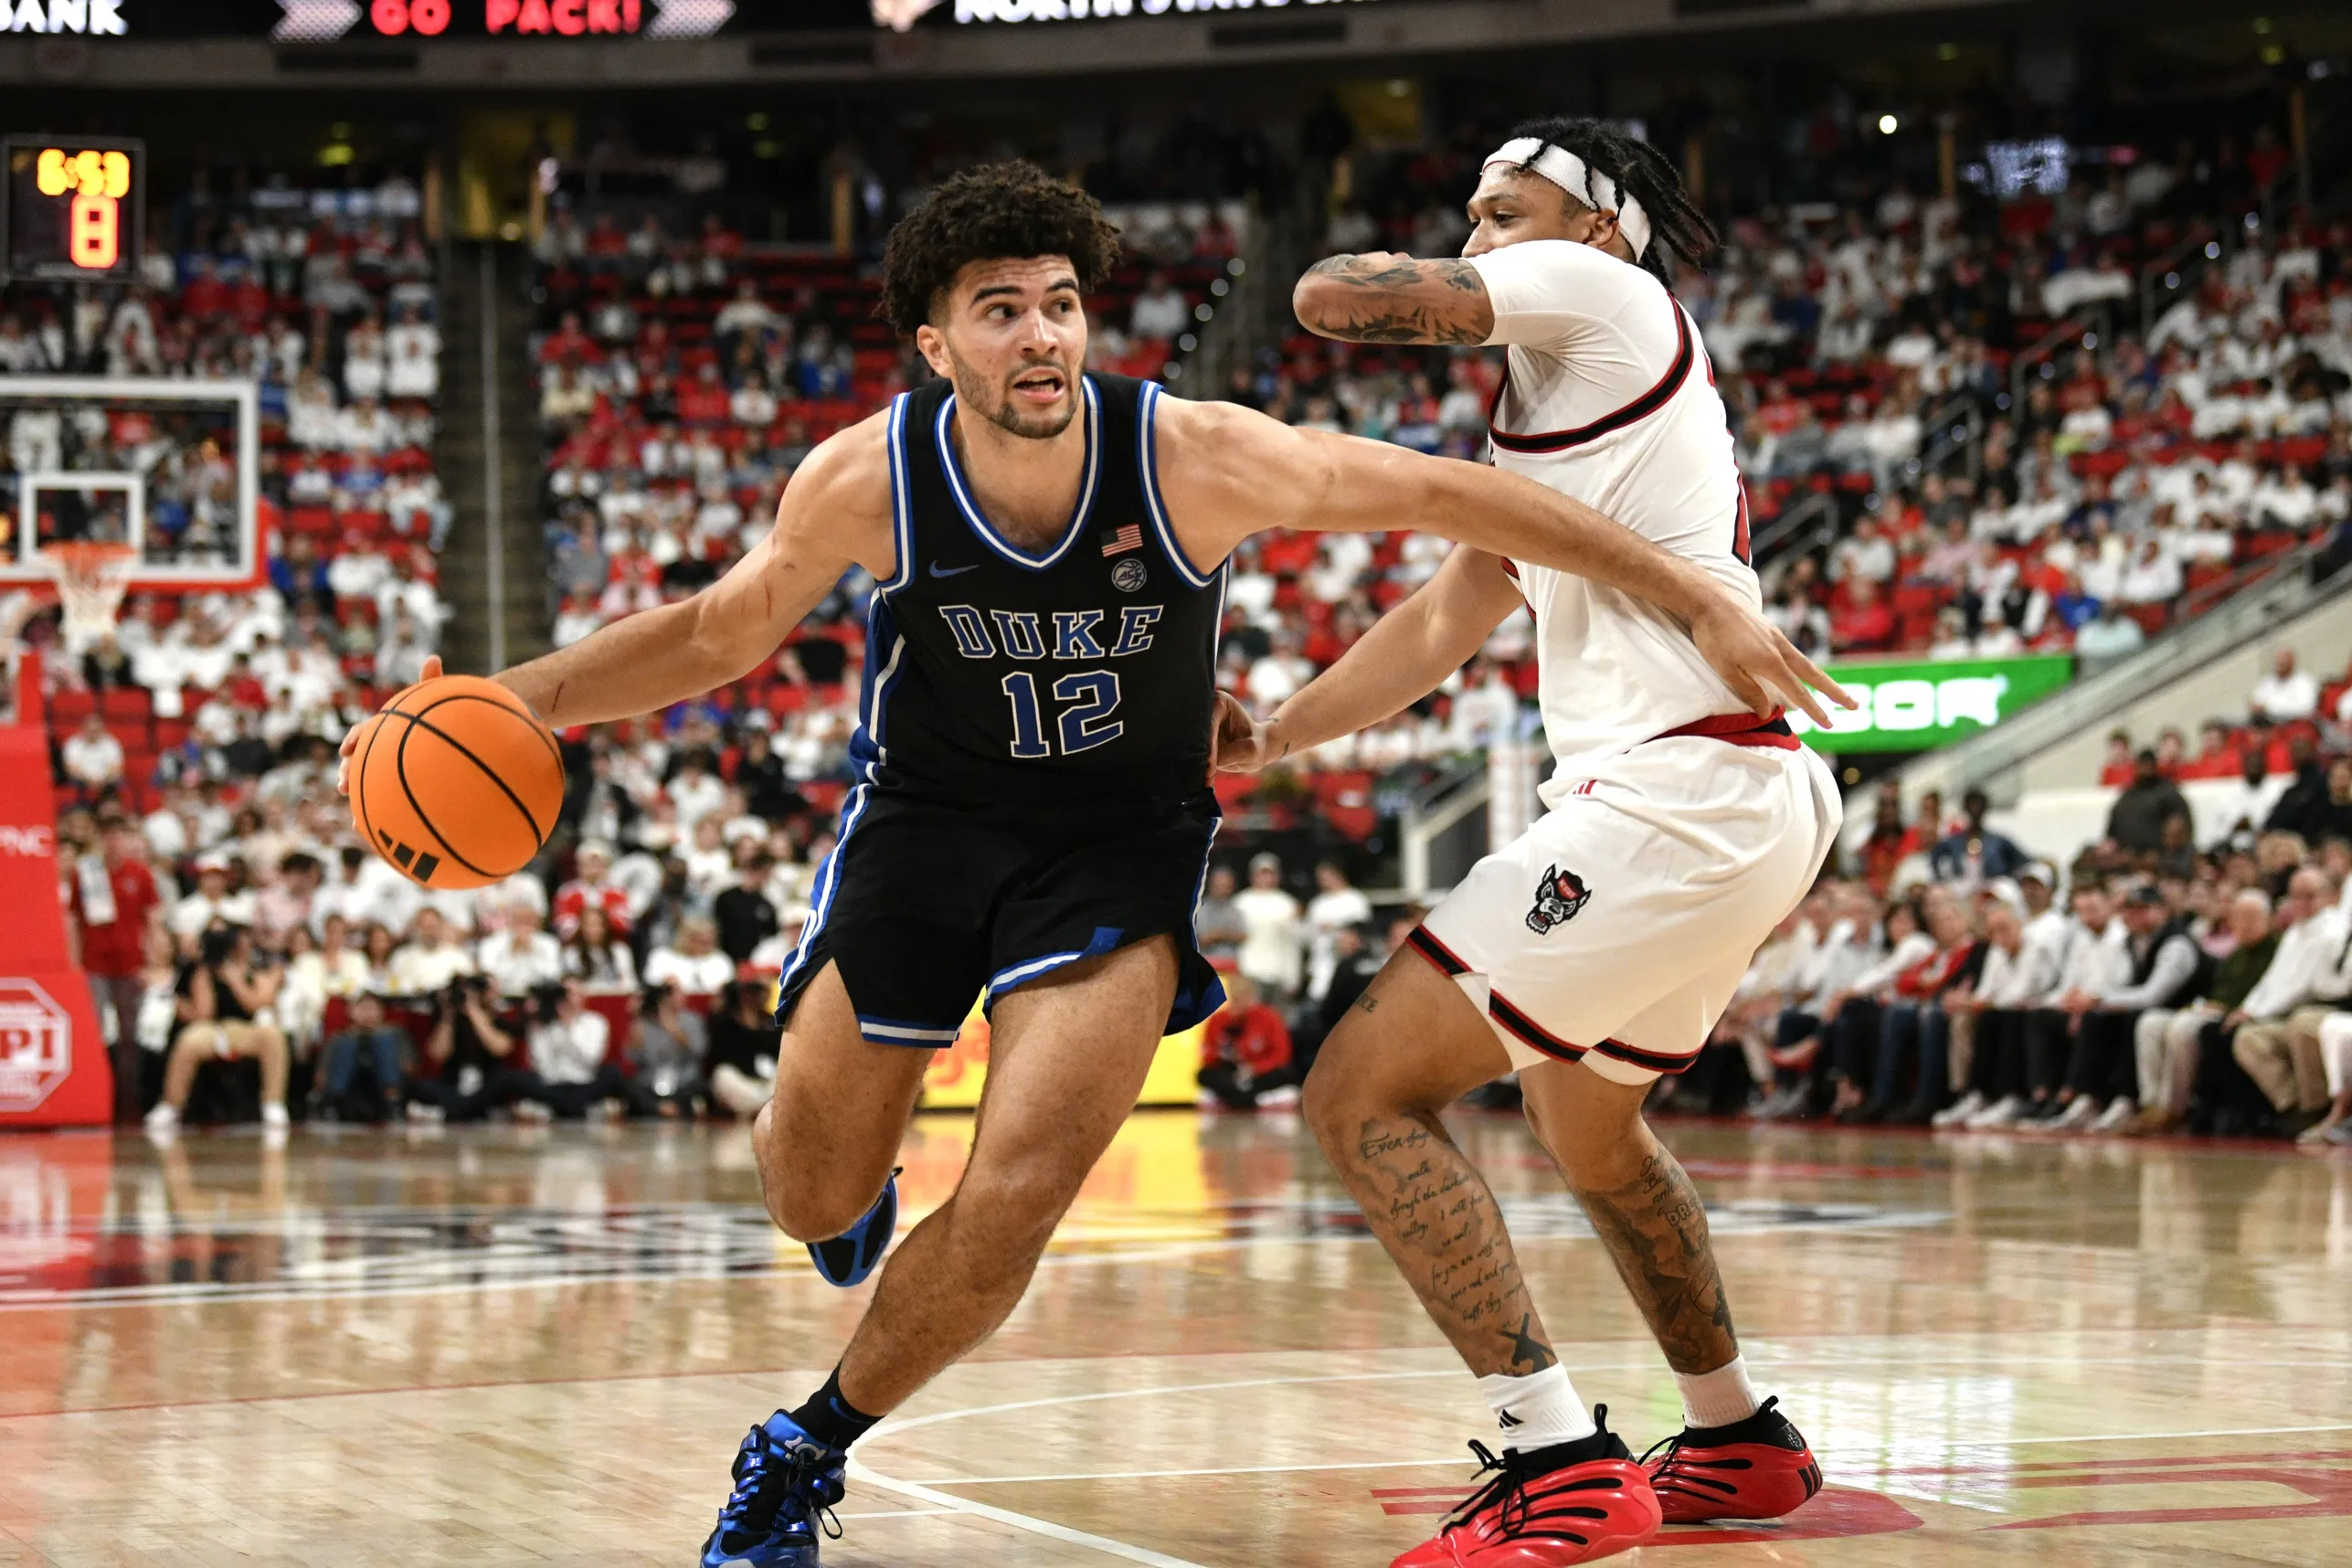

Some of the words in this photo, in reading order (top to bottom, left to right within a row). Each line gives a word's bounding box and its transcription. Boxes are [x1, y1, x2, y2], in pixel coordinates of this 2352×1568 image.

[370, 0, 451, 36] GO
[485, 0, 640, 36] PACK!
[70, 194, 119, 268] 8
[938, 604, 1164, 660] DUKE
[1001, 669, 1124, 758] 12
